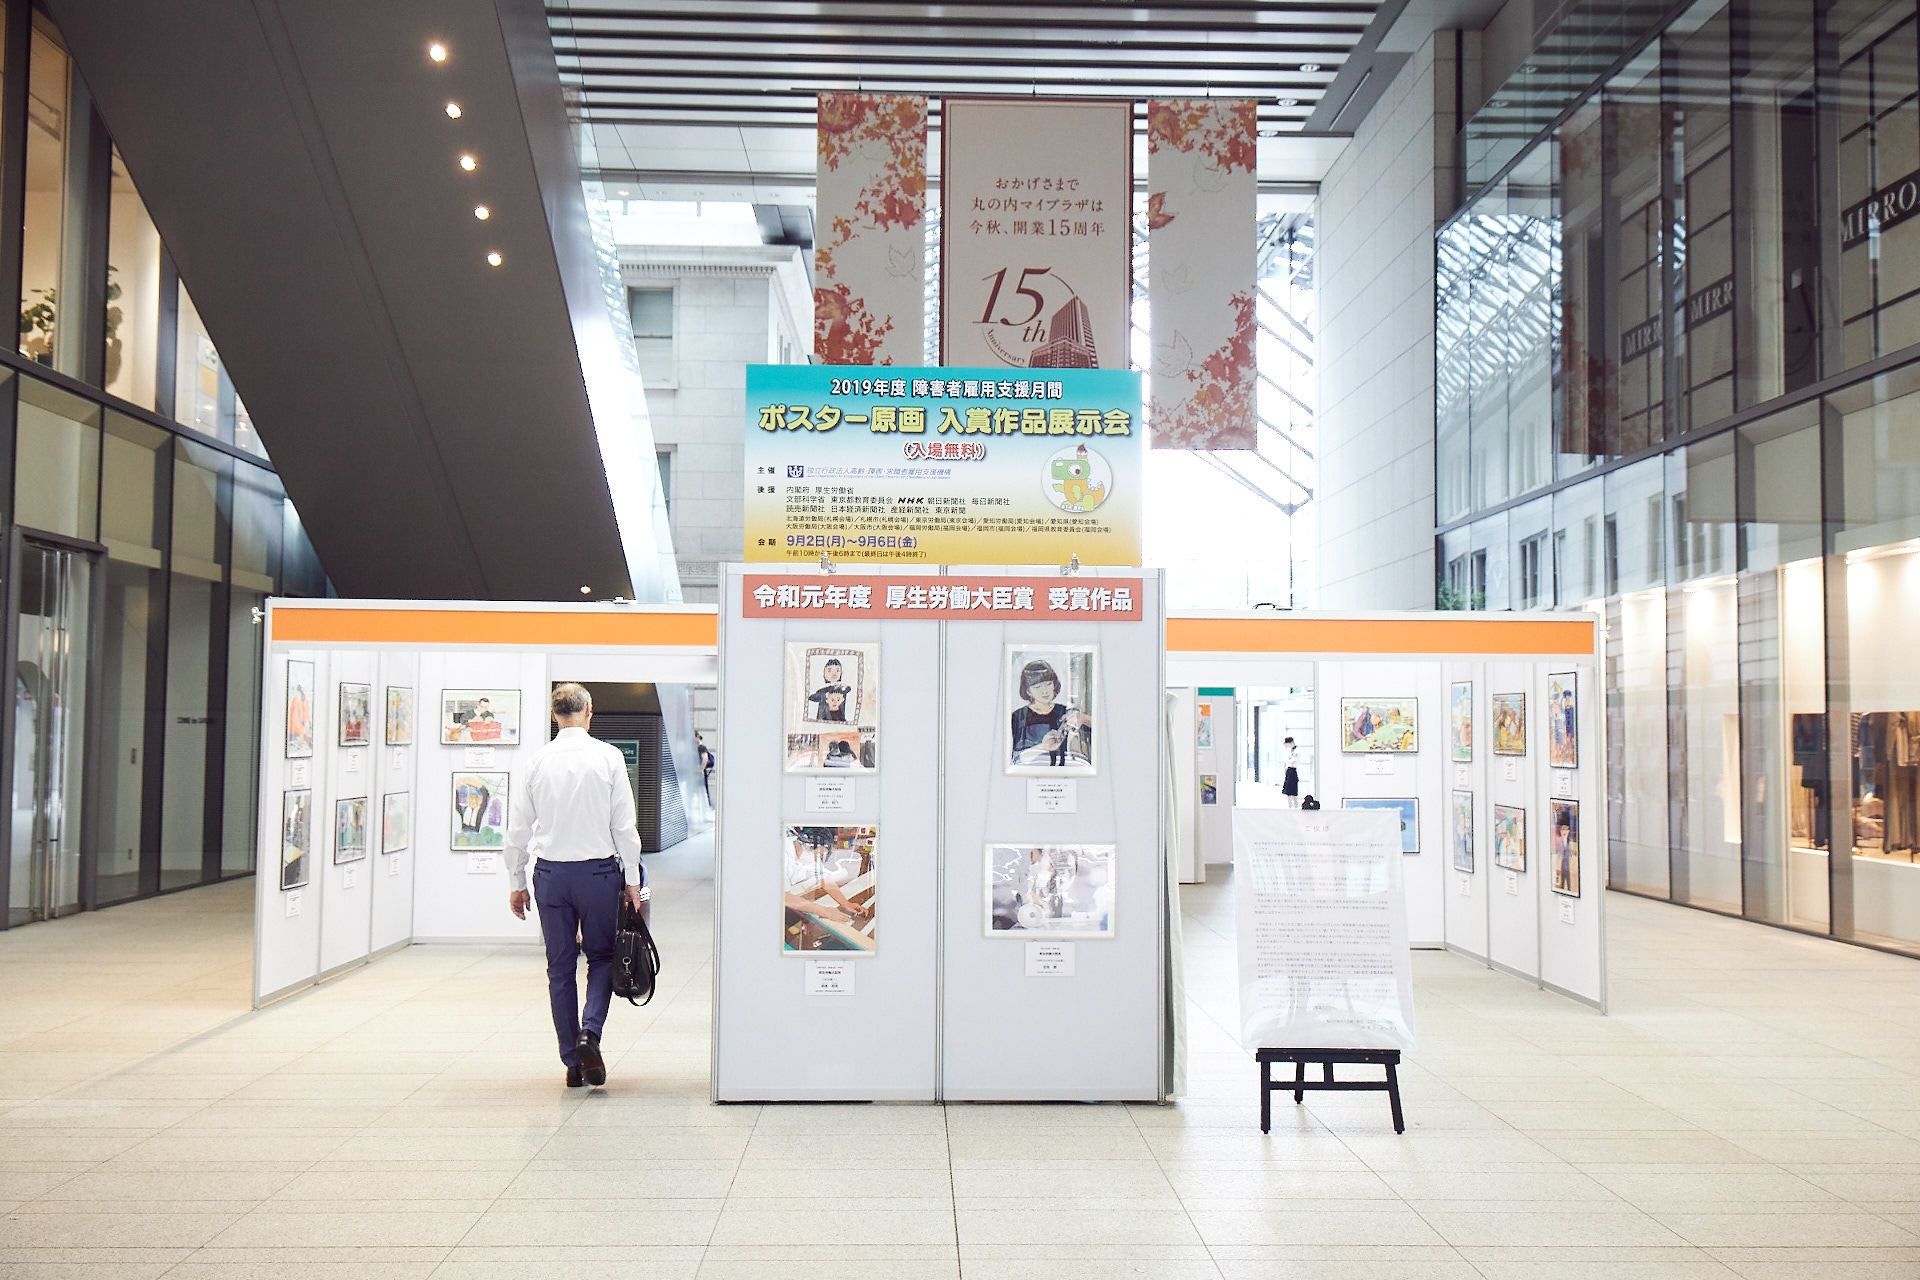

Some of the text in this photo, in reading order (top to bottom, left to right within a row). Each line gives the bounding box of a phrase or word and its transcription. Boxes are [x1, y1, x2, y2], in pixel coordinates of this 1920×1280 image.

[995, 177, 1080, 191] おかげさまで
[971, 197, 1104, 212] 丸の内マイプラザは
[1841, 181, 1920, 242] MIRRO
[969, 218, 1105, 237] 今秋、開業15周年
[972, 266, 1052, 326] 15
[830, 379, 1063, 398] 2019年度 障害者雇用支援月間
[758, 405, 1131, 436] ポスター原画 入賞作品展示会
[752, 584, 1133, 612] 令和元年度 厚生労働大臣賞 受賞作品
